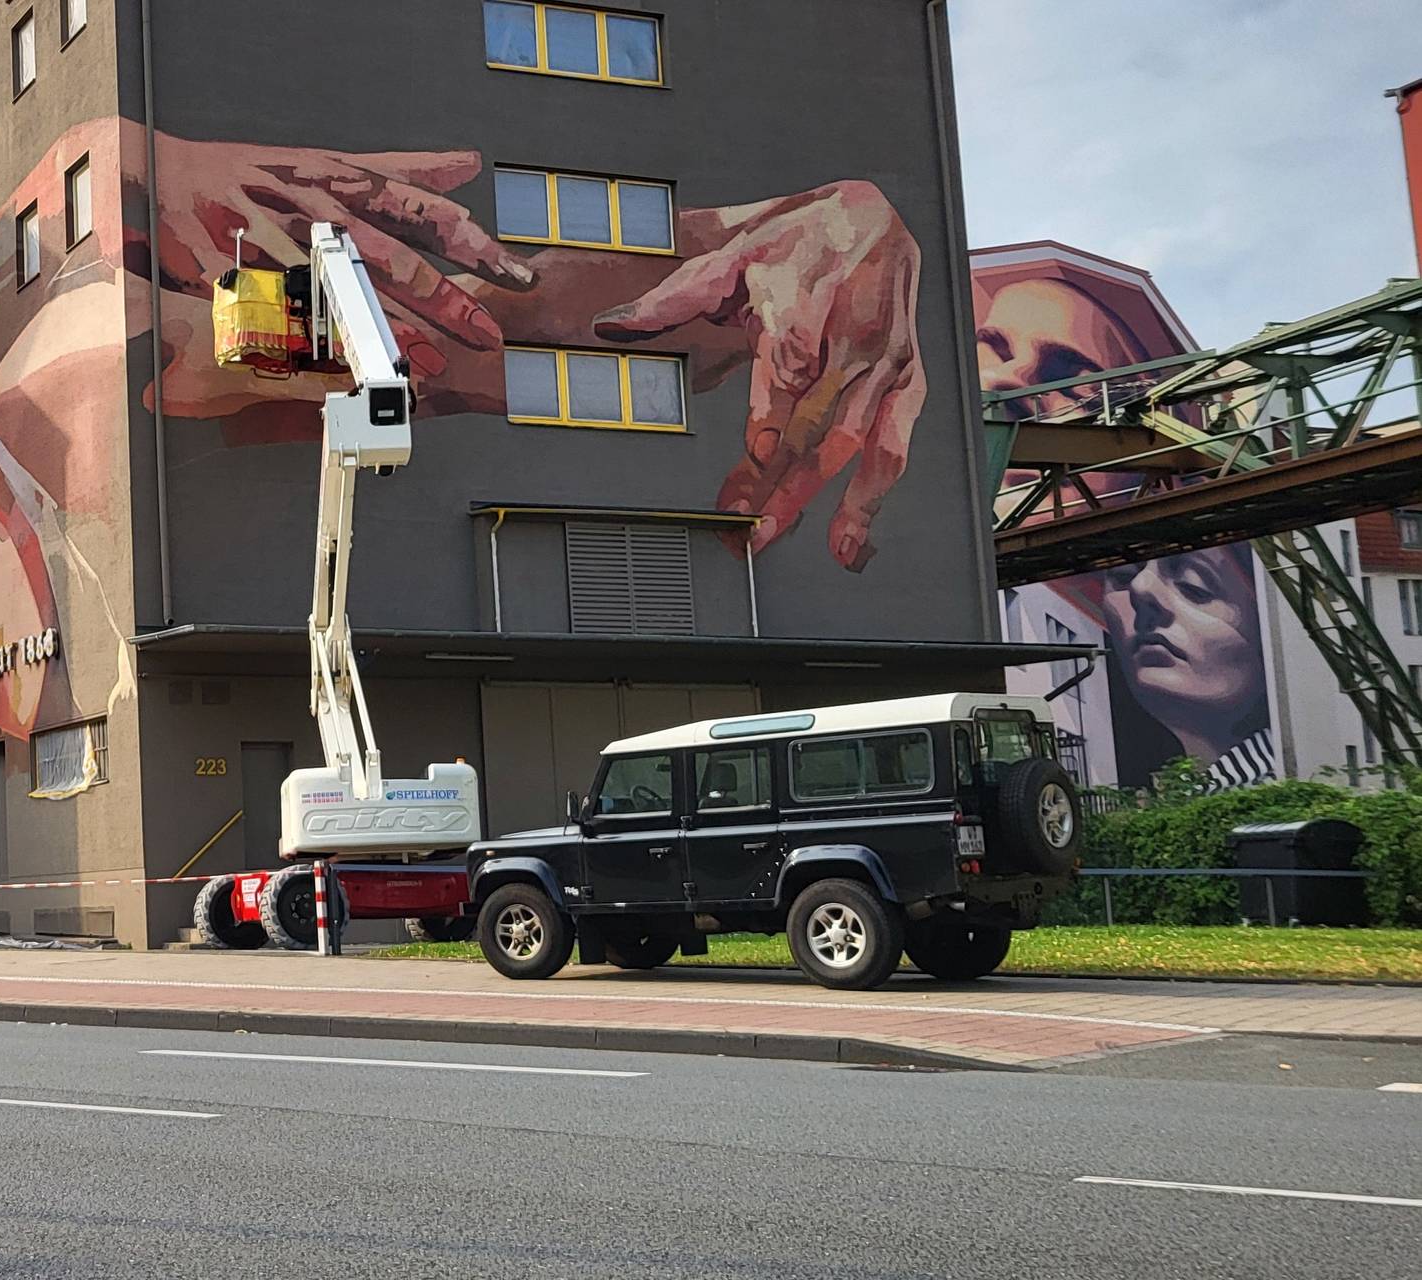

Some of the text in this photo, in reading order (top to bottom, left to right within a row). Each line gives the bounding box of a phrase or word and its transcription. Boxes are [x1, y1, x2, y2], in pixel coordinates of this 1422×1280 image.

[195, 758, 227, 775] 223
[394, 789, 459, 800] SPIELHOFF
[306, 807, 468, 833] nifty
